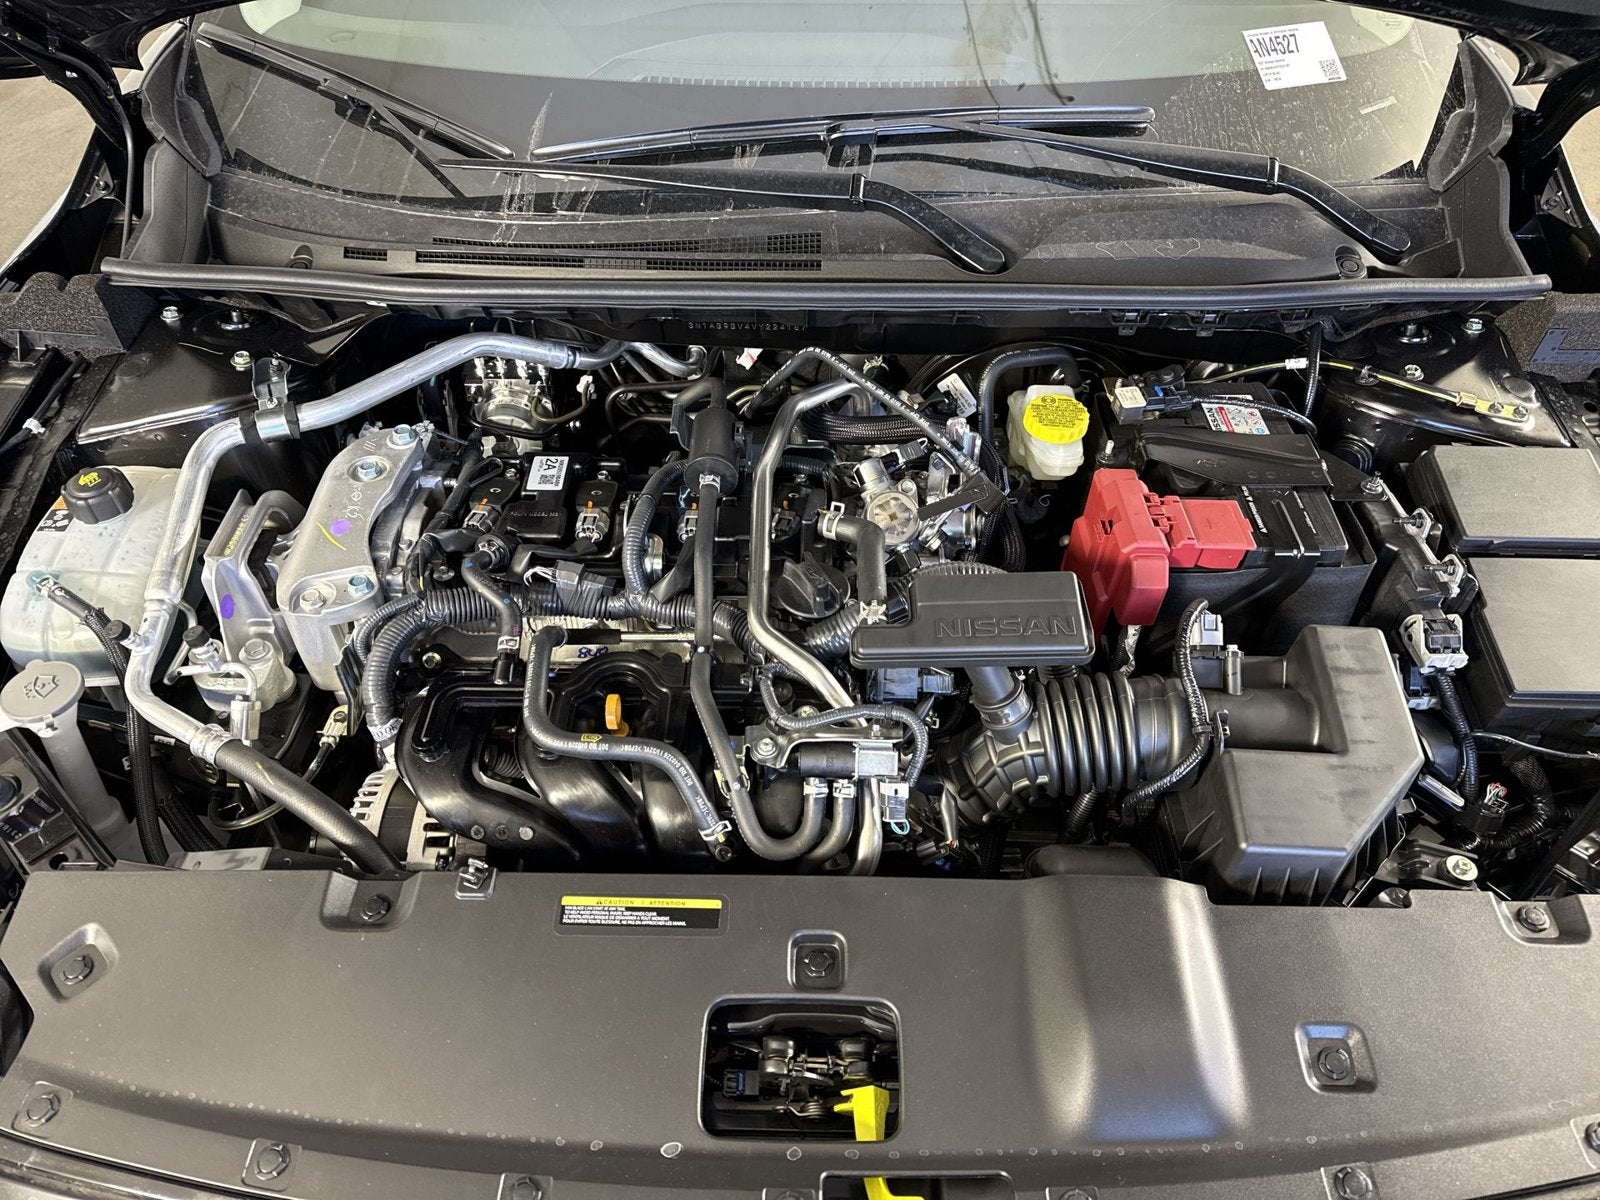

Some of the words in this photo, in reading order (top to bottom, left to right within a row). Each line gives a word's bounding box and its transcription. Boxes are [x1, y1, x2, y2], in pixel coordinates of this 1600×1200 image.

[1249, 34, 1300, 58] AN4527
[1206, 408, 1222, 431] ISSAN
[544, 458, 558, 470] 2A
[936, 616, 1078, 638] NISSAN
